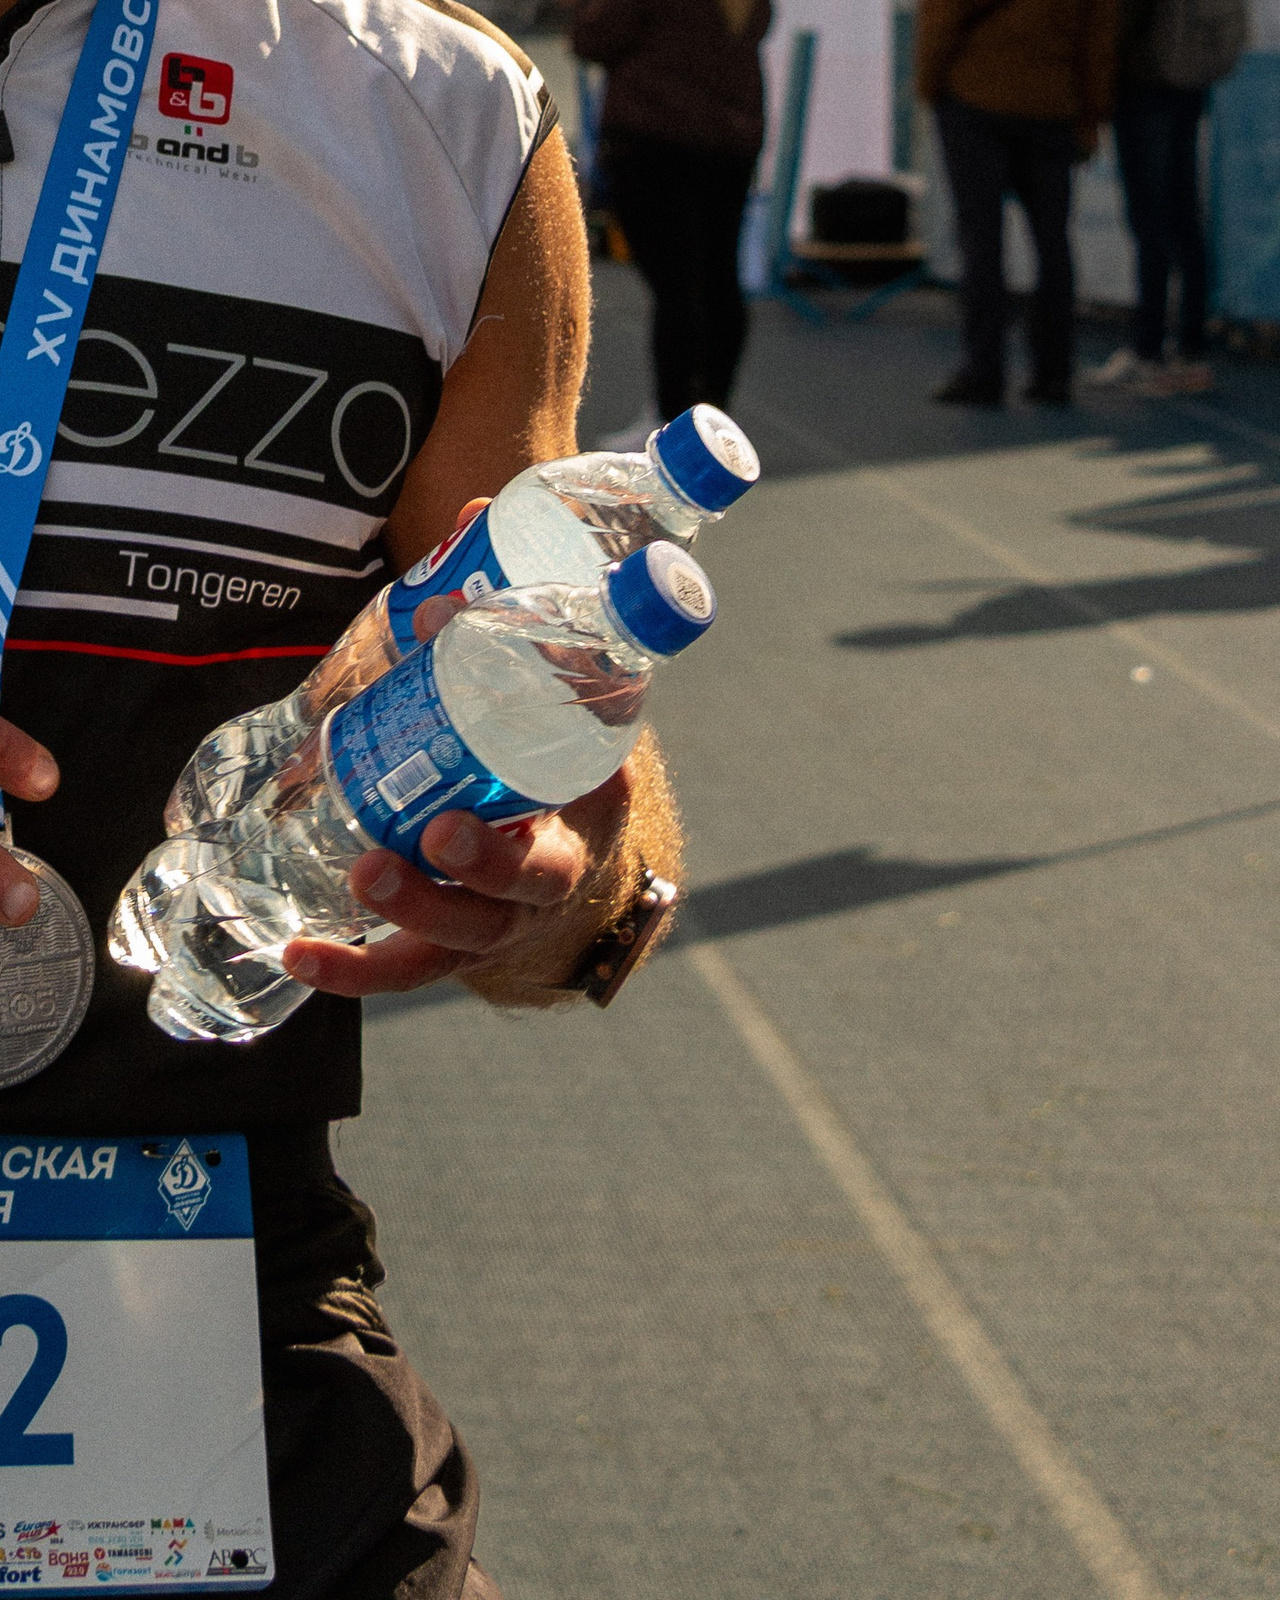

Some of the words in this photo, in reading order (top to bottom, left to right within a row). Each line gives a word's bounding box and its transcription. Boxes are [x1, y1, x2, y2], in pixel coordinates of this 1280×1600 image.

[156, 138, 230, 165] and
[235, 144, 260, 169] b
[26, 288, 76, 367] XV
[118, 549, 302, 611] Tongeren
